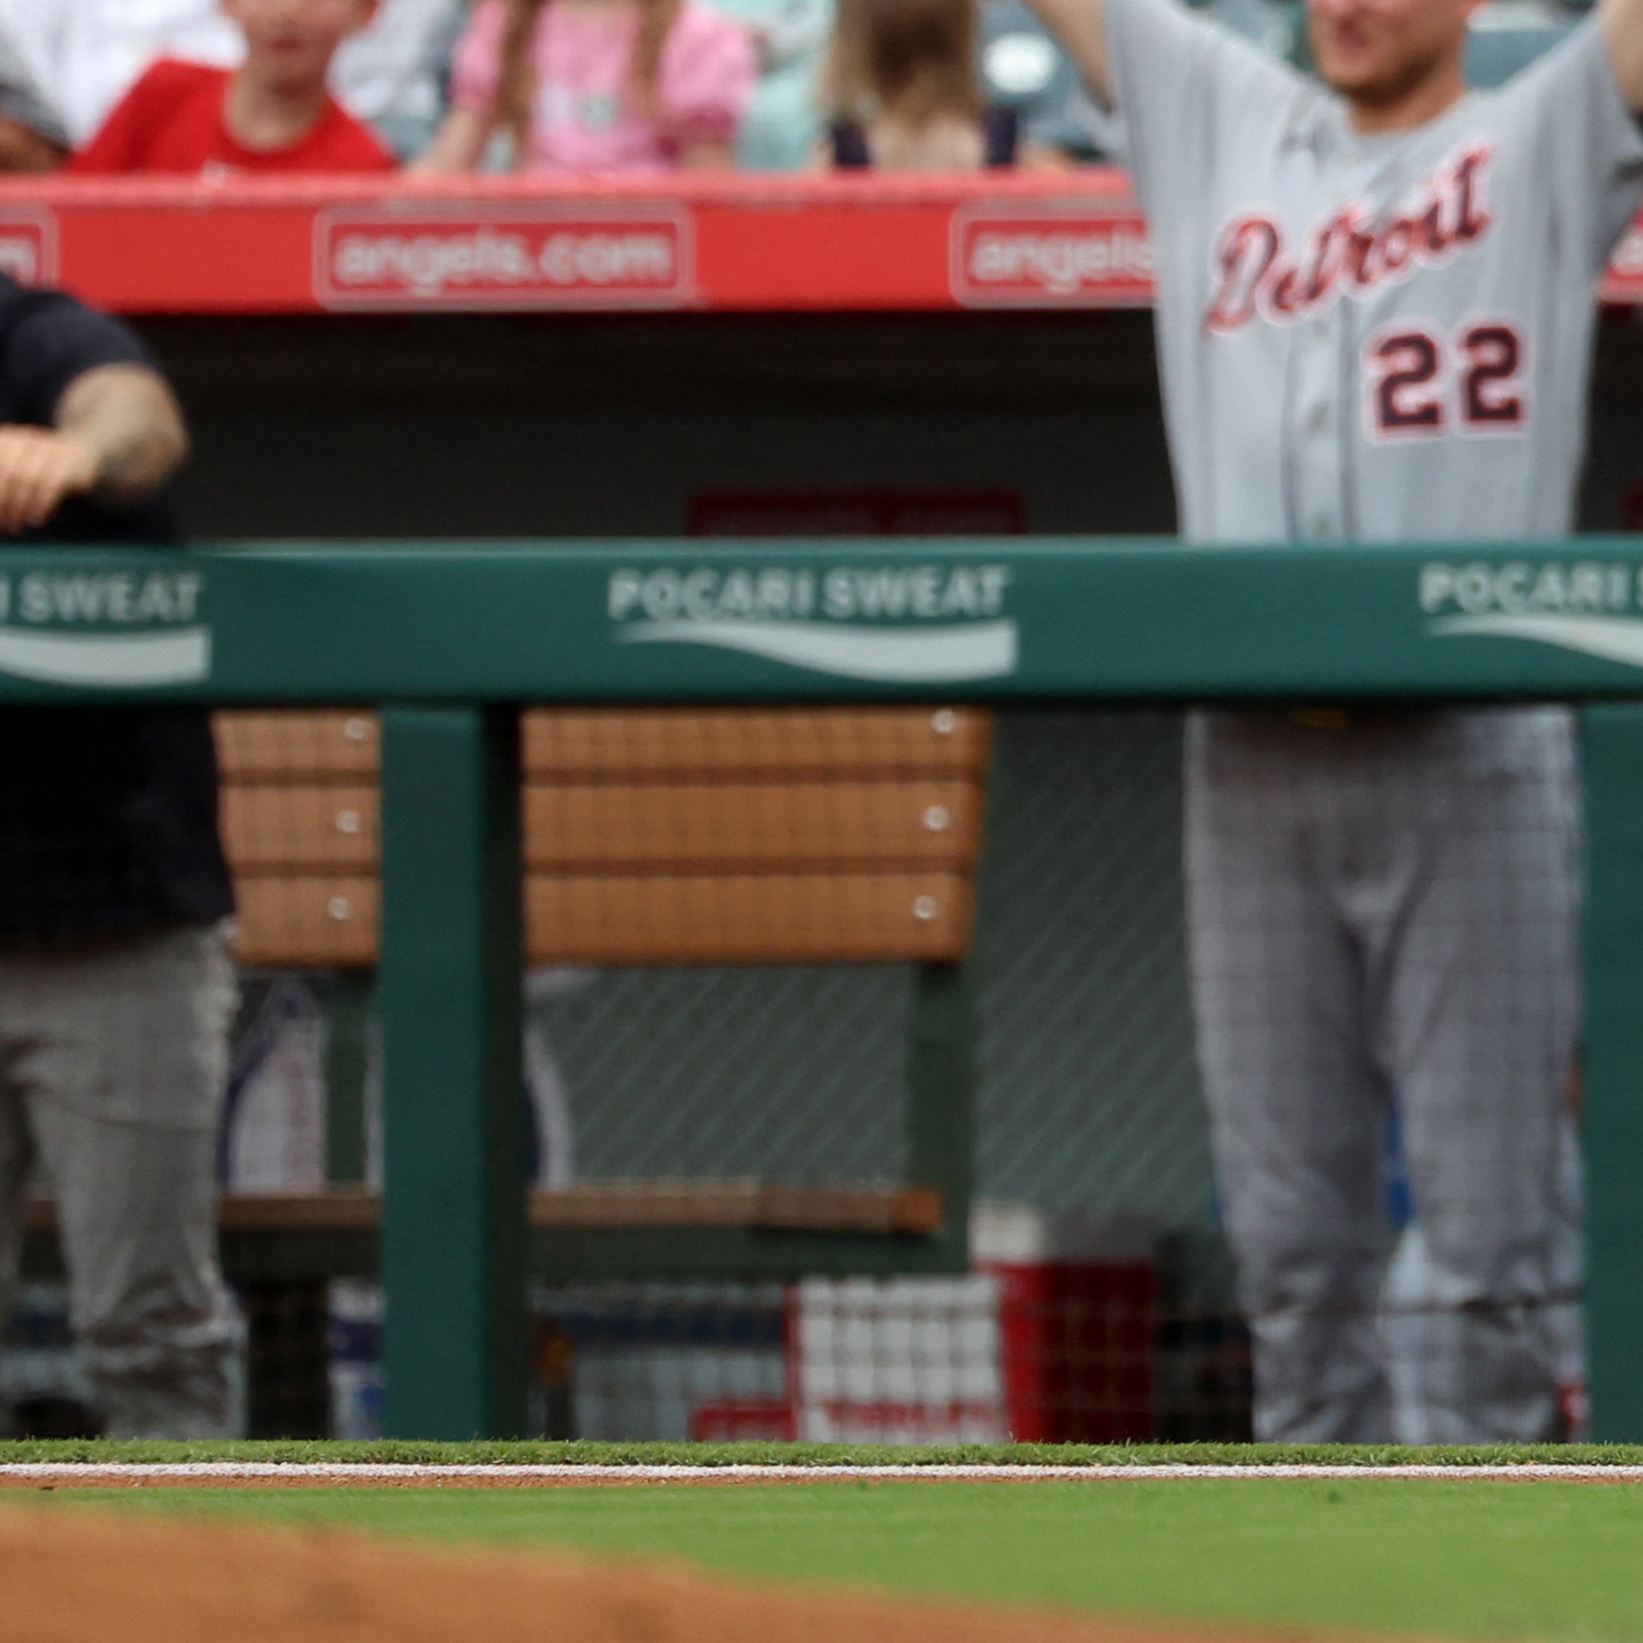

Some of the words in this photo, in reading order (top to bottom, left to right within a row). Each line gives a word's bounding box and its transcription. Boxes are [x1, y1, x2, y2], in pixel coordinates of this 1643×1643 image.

[332, 226, 674, 297] angels.com
[1205, 143, 1493, 335] Detroit
[1362, 319, 1528, 444] 22
[18, 571, 203, 624] SWEAT
[608, 565, 813, 621] POCARI
[821, 564, 1011, 619] SWEAT
[1418, 561, 1622, 615] POCARI
